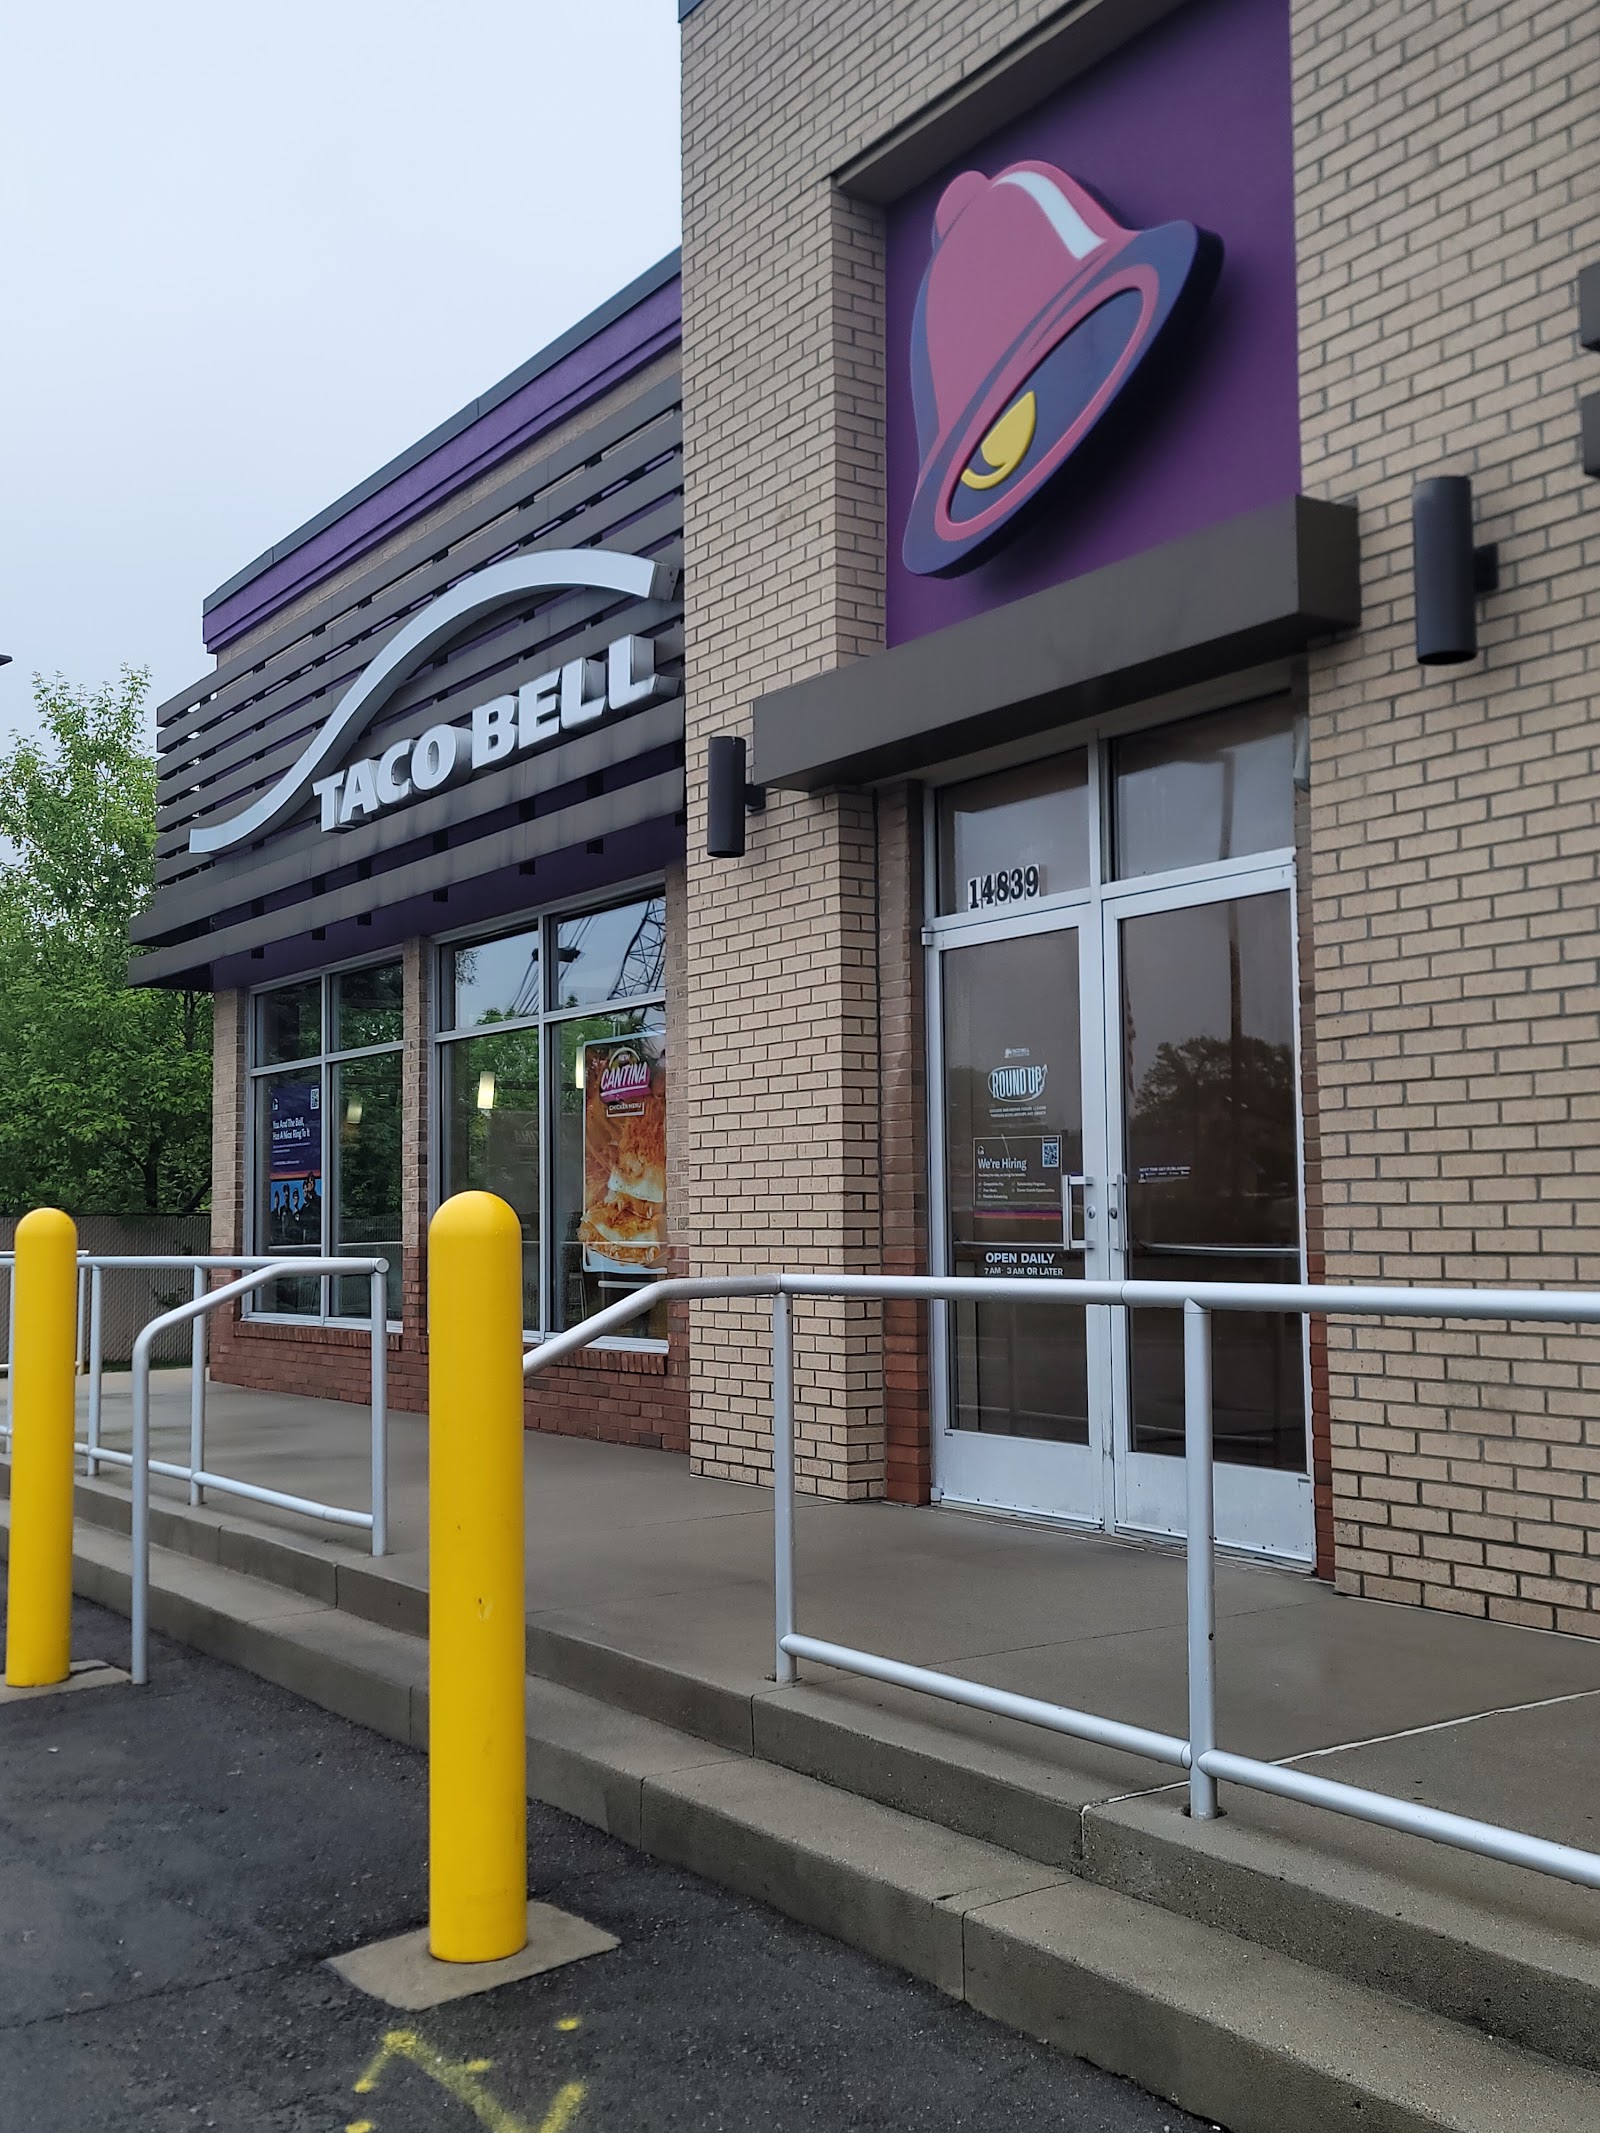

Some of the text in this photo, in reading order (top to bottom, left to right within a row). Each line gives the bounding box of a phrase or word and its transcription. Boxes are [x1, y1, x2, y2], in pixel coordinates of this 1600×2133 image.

[312, 633, 658, 833] TACO BELL
[969, 865, 1039, 909] 14839
[600, 1061, 649, 1090] CANTINA
[991, 1065, 1042, 1098] ROUND UP
[978, 1157, 1027, 1171] We're Hiring
[985, 1252, 1055, 1264] OPEN DAILY
[1026, 1267, 1038, 1275] OR
[1039, 1267, 1063, 1276] LATER
